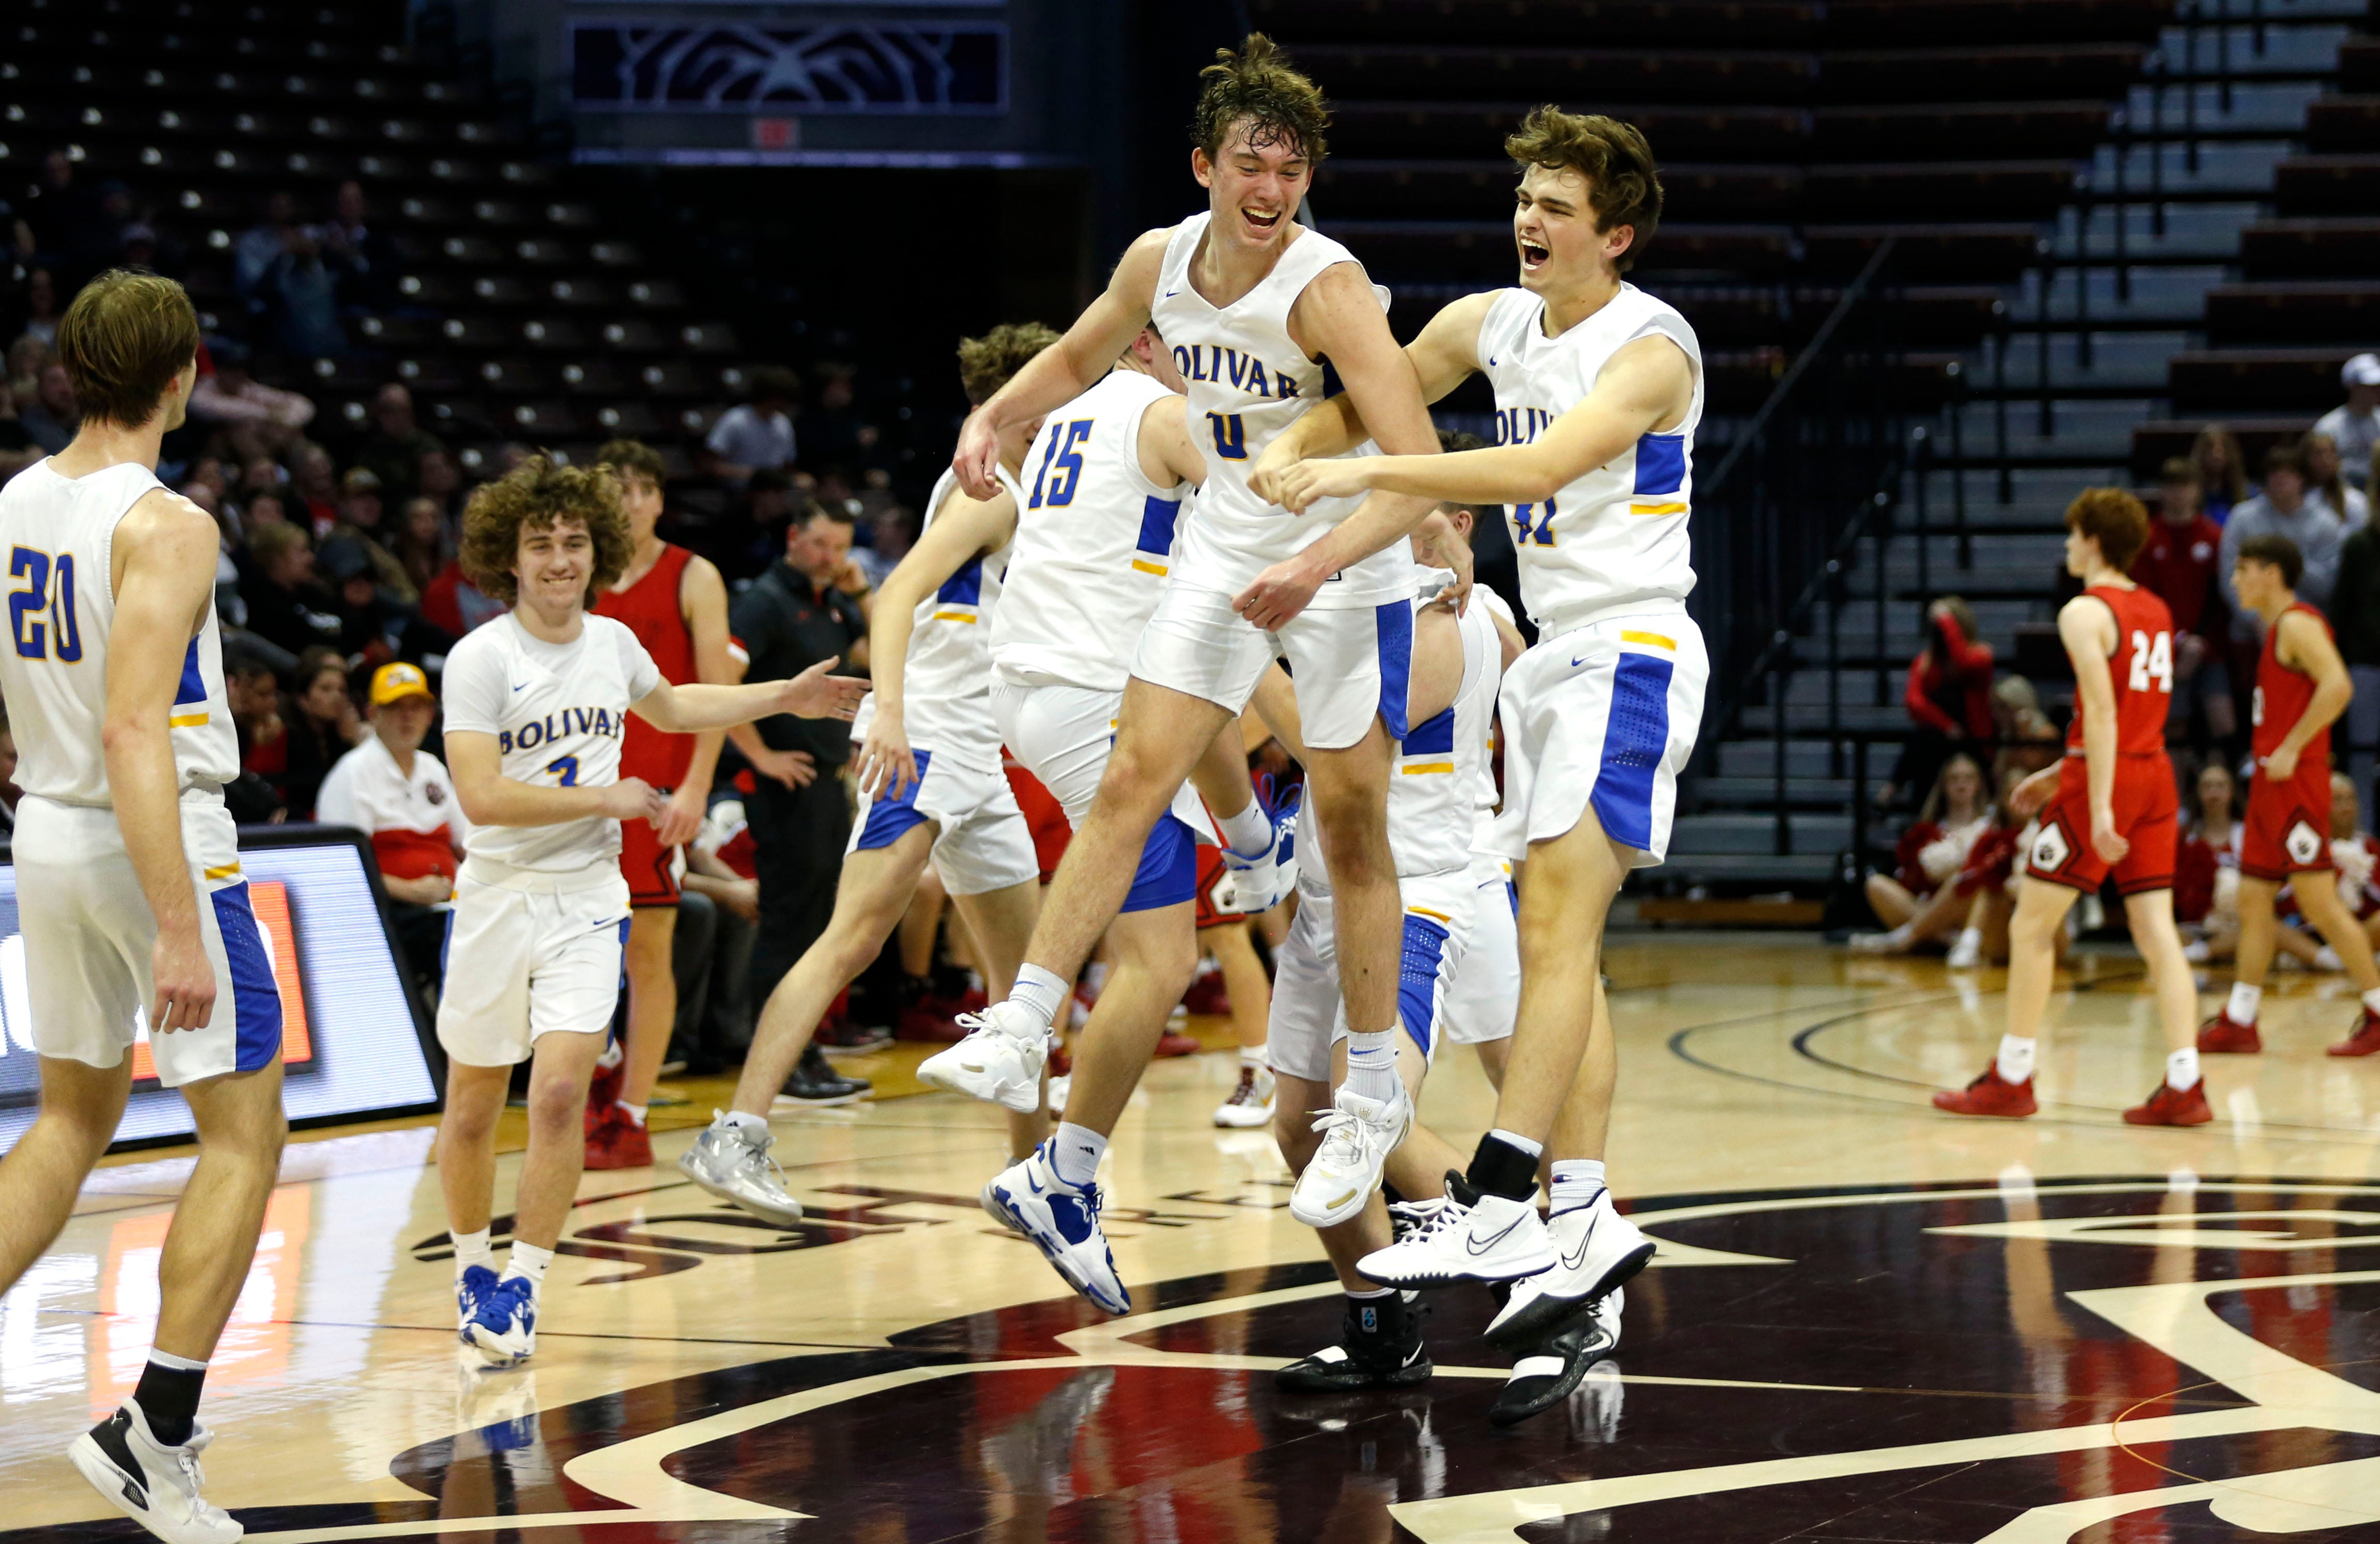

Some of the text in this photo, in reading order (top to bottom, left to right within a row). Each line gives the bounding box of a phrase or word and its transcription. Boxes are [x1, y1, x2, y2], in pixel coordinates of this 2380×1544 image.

[1173, 343, 1301, 400] OLIVAR
[1027, 417, 1096, 511] 15
[8, 543, 84, 665] 20
[2128, 629, 2173, 693] 24
